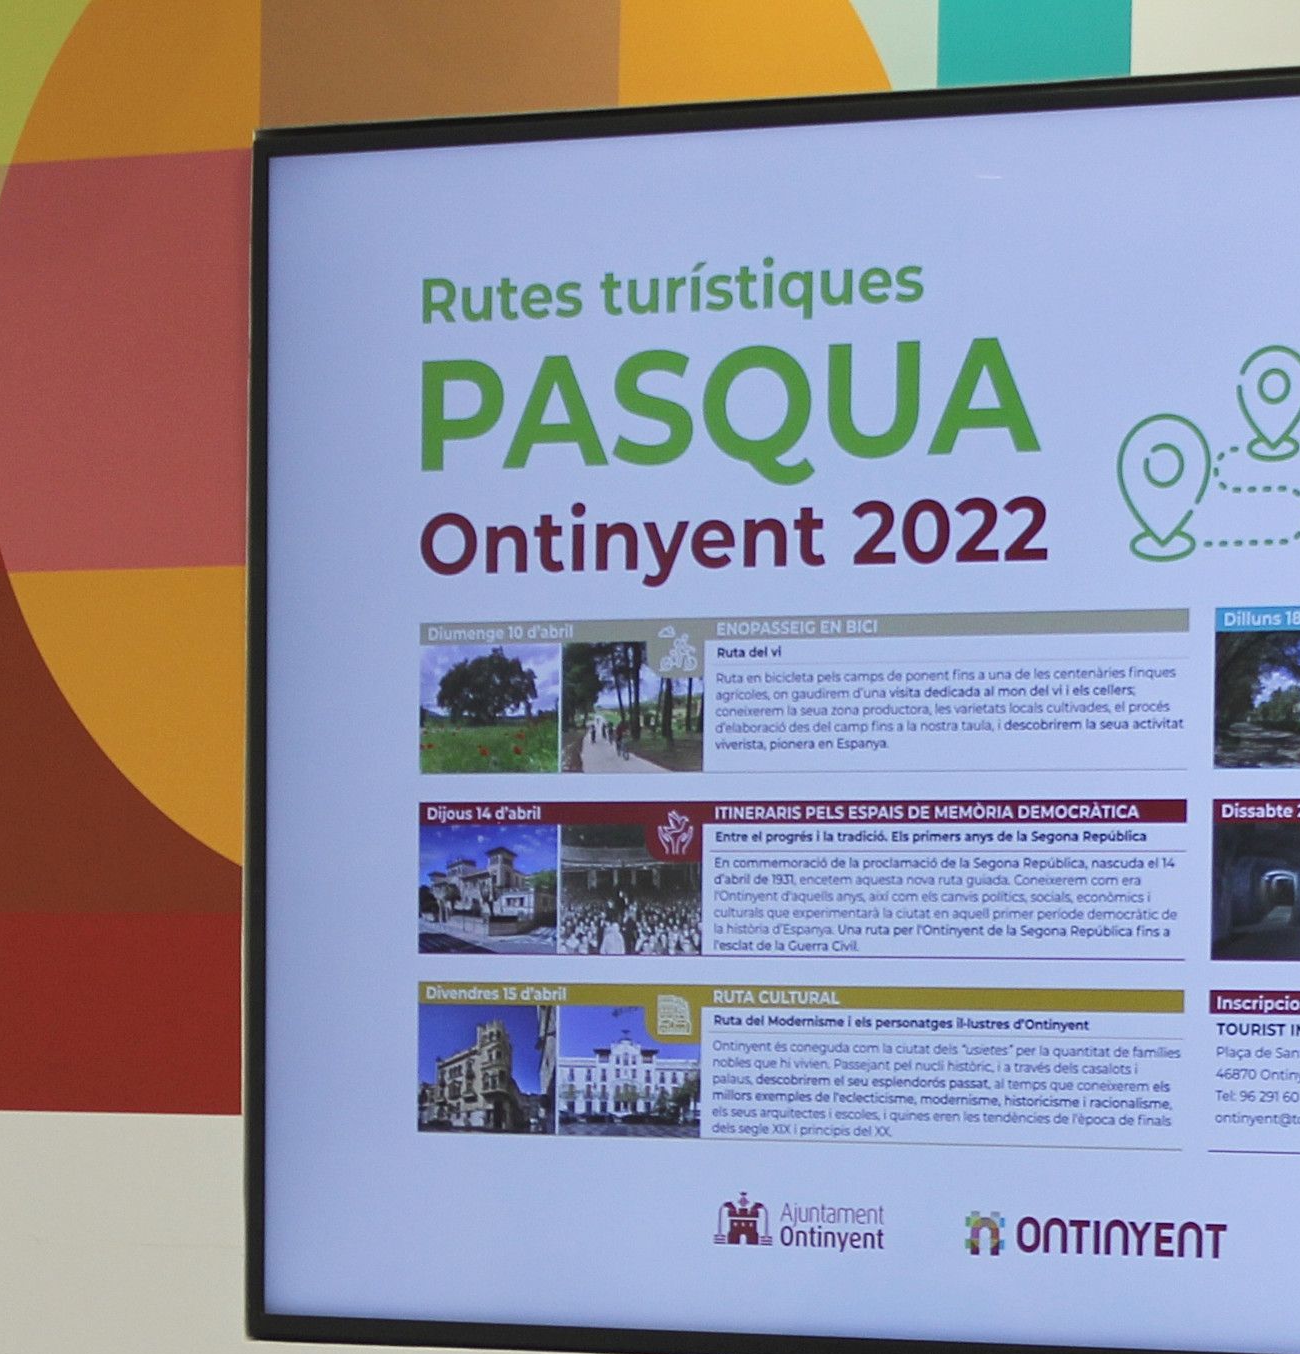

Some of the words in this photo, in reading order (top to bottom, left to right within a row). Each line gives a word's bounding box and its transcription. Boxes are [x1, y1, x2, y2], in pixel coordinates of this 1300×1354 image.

[422, 277, 582, 324] Rutes
[602, 257, 924, 319] turístiques
[421, 337, 1041, 484] PASQUA
[420, 502, 825, 587] Ontinyent
[852, 496, 1049, 565] 2022
[1223, 610, 1281, 626] Dilluns
[427, 626, 504, 642] Diumenge
[507, 625, 523, 639] 10
[716, 620, 815, 635] ENOPASSEIG
[820, 619, 841, 634] EN
[846, 618, 877, 633] BICI
[716, 647, 745, 658] Ruta
[748, 646, 767, 657] del
[770, 645, 781, 657] vi
[426, 805, 472, 822] Dijous
[475, 806, 492, 819] 14
[714, 805, 801, 819] ITINERARIS
[805, 805, 844, 819] PELS
[848, 805, 904, 819] ESPAIS
[907, 804, 930, 819] DE
[934, 803, 1014, 819] MEMÒRIA
[1017, 803, 1140, 818] DEMOCRÀTICA
[1221, 802, 1293, 818] Dissabte
[715, 831, 748, 842] Entre
[751, 830, 762, 842] el
[765, 831, 813, 844] progrés
[816, 829, 820, 841] i
[822, 830, 833, 842] la
[837, 830, 888, 841] tradició.
[891, 830, 909, 842] Els
[912, 830, 961, 843] primers
[964, 832, 994, 844] anys
[996, 830, 1013, 842] de
[1016, 830, 1027, 842] la
[1031, 830, 1079, 844] Segona
[1082, 829, 1147, 843] República
[425, 985, 499, 1000] Divendres
[502, 986, 517, 1000] 15
[713, 989, 755, 1003] RUTA
[758, 990, 840, 1004] CULTURAL
[713, 1014, 742, 1025] Ruta
[745, 1014, 764, 1026] del
[767, 1015, 844, 1026] Modernisme
[847, 1014, 851, 1027] i
[854, 1016, 872, 1027] els
[875, 1018, 953, 1031] personatges
[1215, 1022, 1286, 1036] TOURIST
[1215, 1045, 1251, 1060] Plaça
[1254, 1046, 1272, 1058] de
[1215, 1067, 1257, 1080] 46870
[1239, 1090, 1256, 1102] 96
[1259, 1090, 1279, 1102] 291
[1281, 1090, 1299, 1102] 60
[781, 1202, 884, 1227] Ajuntament
[780, 1225, 884, 1252] Ontinyent
[1016, 1216, 1227, 1259] ONTINYENT
